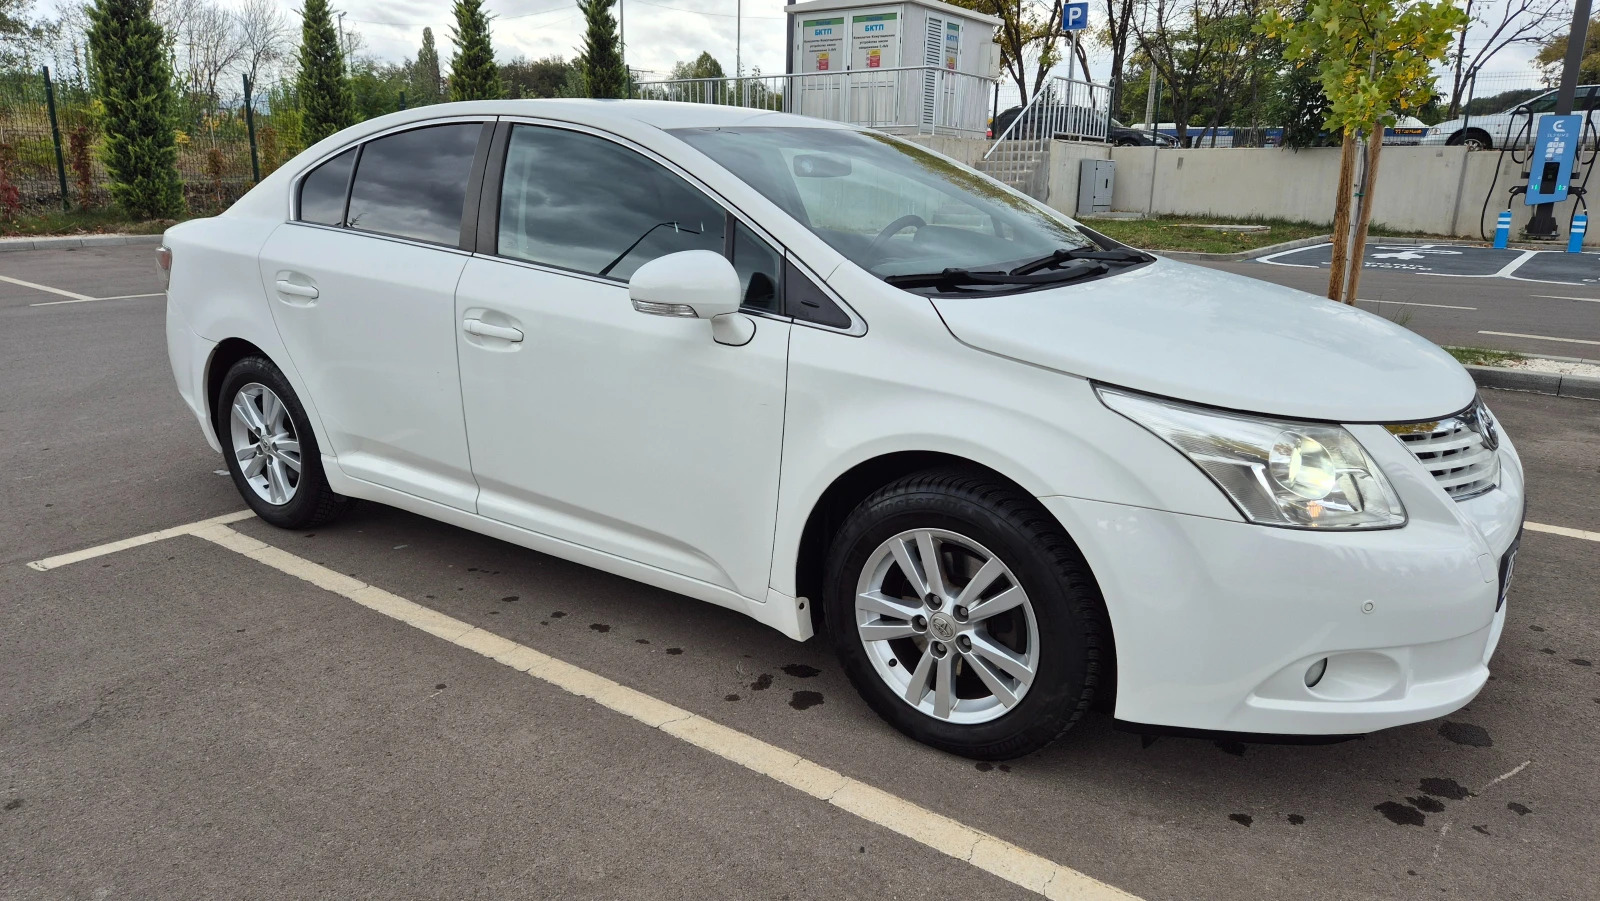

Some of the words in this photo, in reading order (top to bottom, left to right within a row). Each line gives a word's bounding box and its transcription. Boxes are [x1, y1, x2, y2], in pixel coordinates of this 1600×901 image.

[1069, 7, 1081, 26] P
[814, 28, 832, 36] БКТП
[864, 24, 884, 32] БКТП
